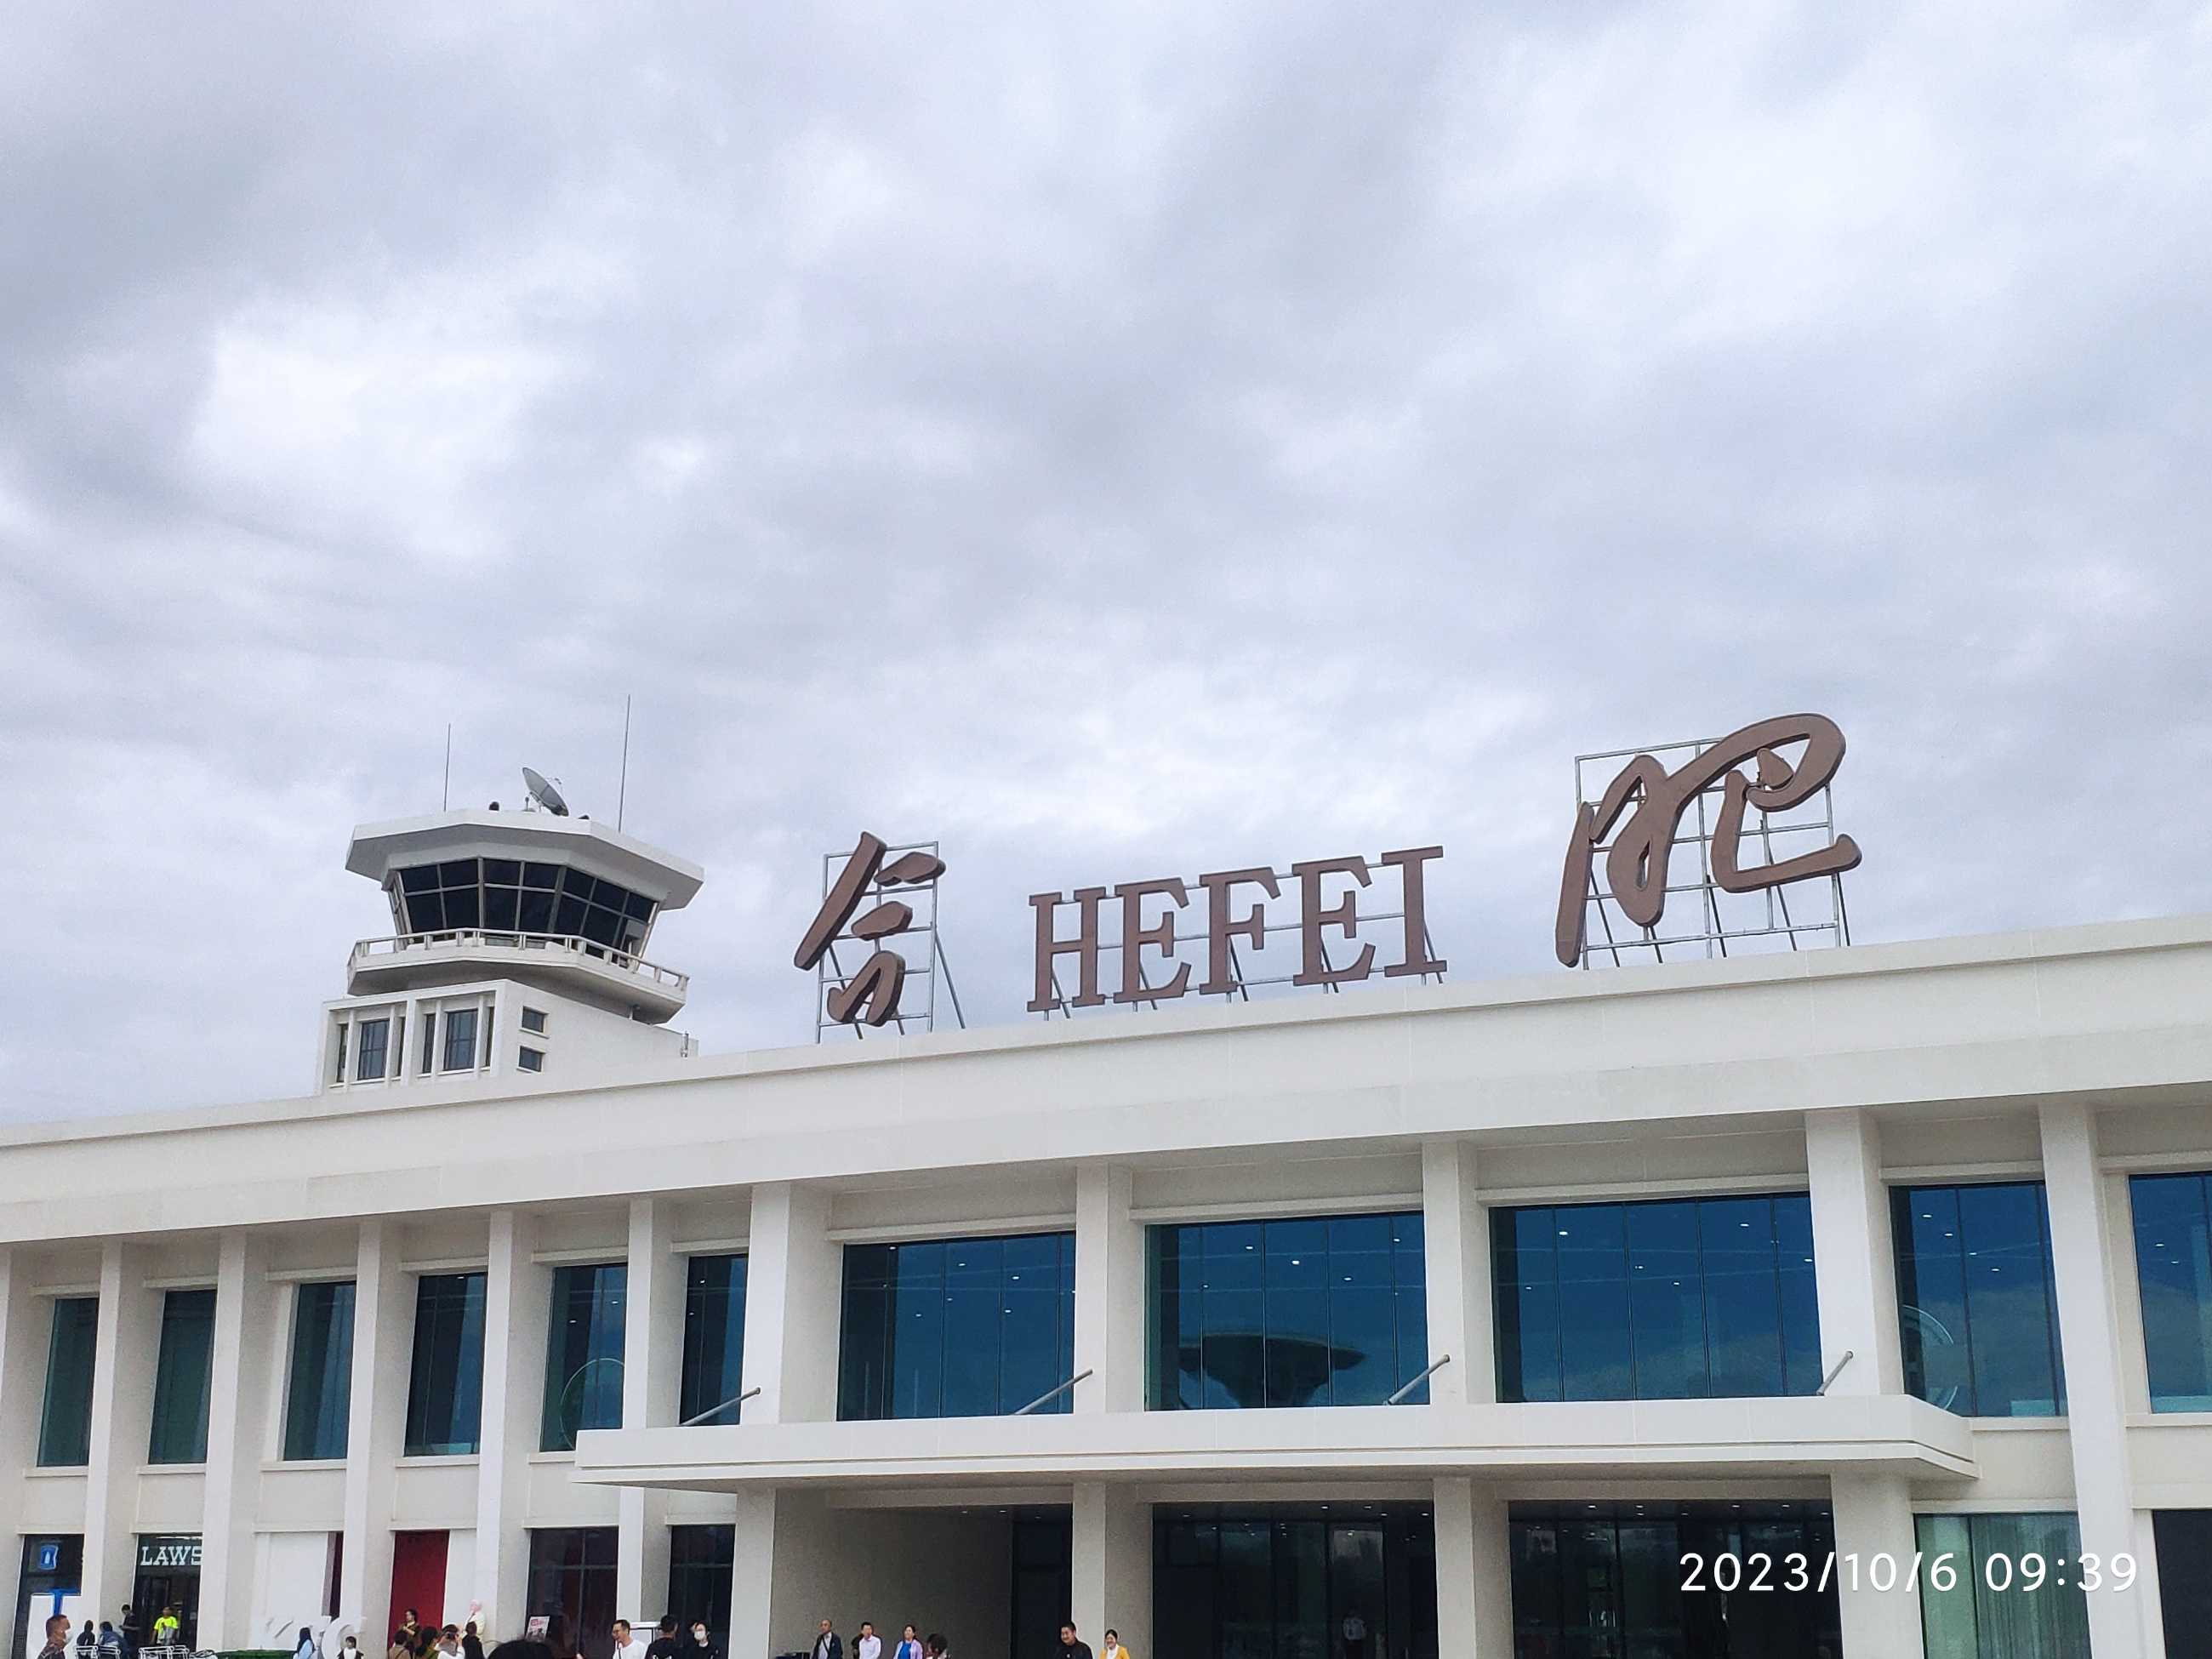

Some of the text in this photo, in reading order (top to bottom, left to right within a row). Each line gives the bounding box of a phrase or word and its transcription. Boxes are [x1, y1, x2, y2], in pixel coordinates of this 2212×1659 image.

[795, 831, 946, 1027] 合
[1026, 846, 1448, 1012] HEFEI
[1555, 713, 1861, 967] 肥
